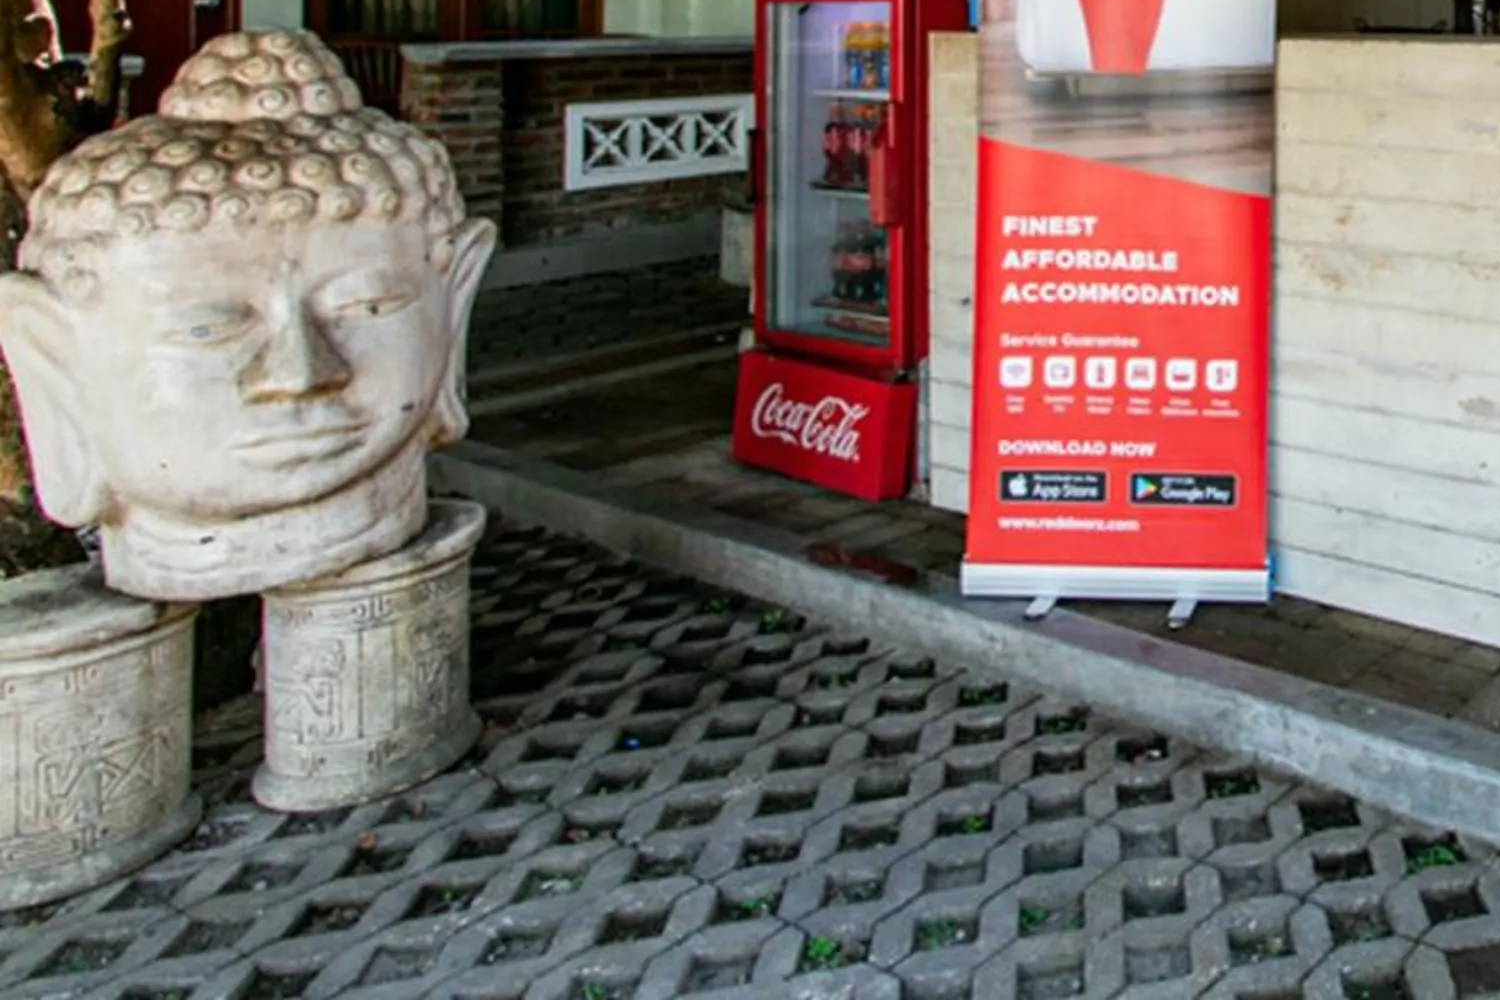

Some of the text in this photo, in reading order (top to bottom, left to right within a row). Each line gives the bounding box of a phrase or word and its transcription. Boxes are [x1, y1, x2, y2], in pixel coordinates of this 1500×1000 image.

[1002, 215, 1098, 237] FINEST
[1002, 250, 1179, 272] AFFORDABLE
[1002, 283, 1240, 307] ACCOMMODATION
[1001, 333, 1056, 348] Service
[998, 440, 1157, 457] DOWNLOAD NOW
[1032, 484, 1099, 500] App Store
[1160, 486, 1231, 504] Google Play
